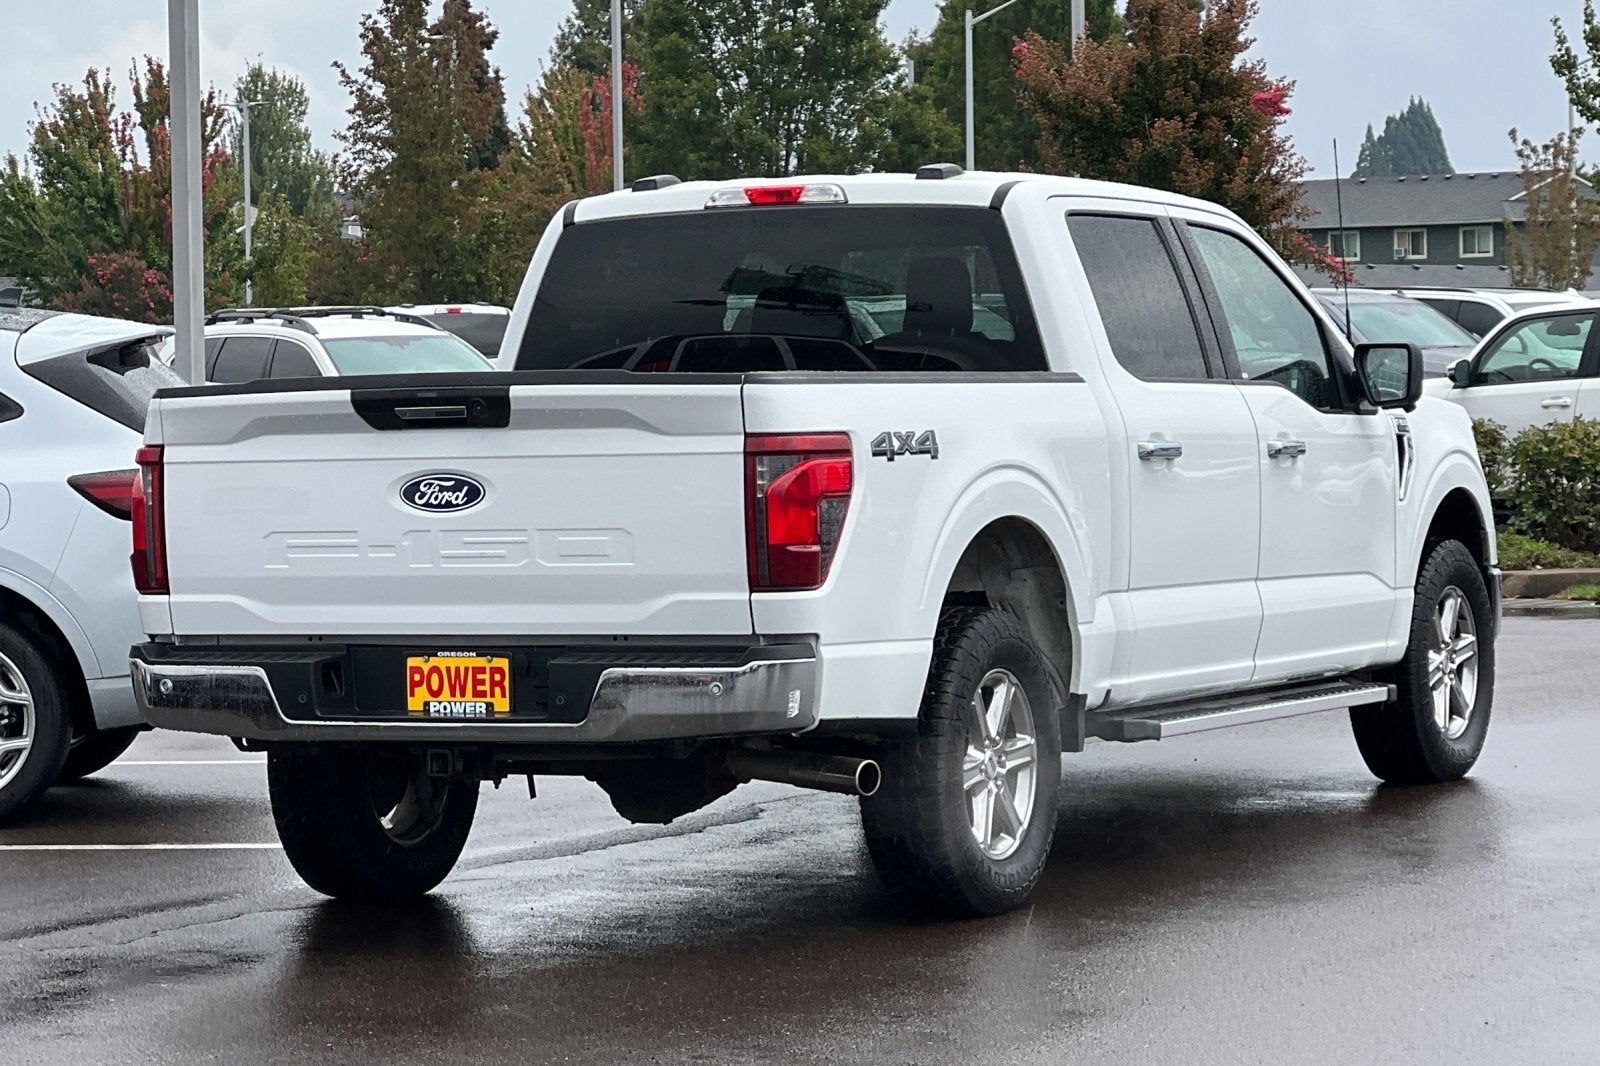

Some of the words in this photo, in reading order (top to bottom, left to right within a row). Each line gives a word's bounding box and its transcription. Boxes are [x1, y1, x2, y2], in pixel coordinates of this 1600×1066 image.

[414, 480, 468, 505] Ford
[263, 528, 634, 569] F-150
[408, 665, 507, 699] POWER
[429, 701, 487, 714] POWER
